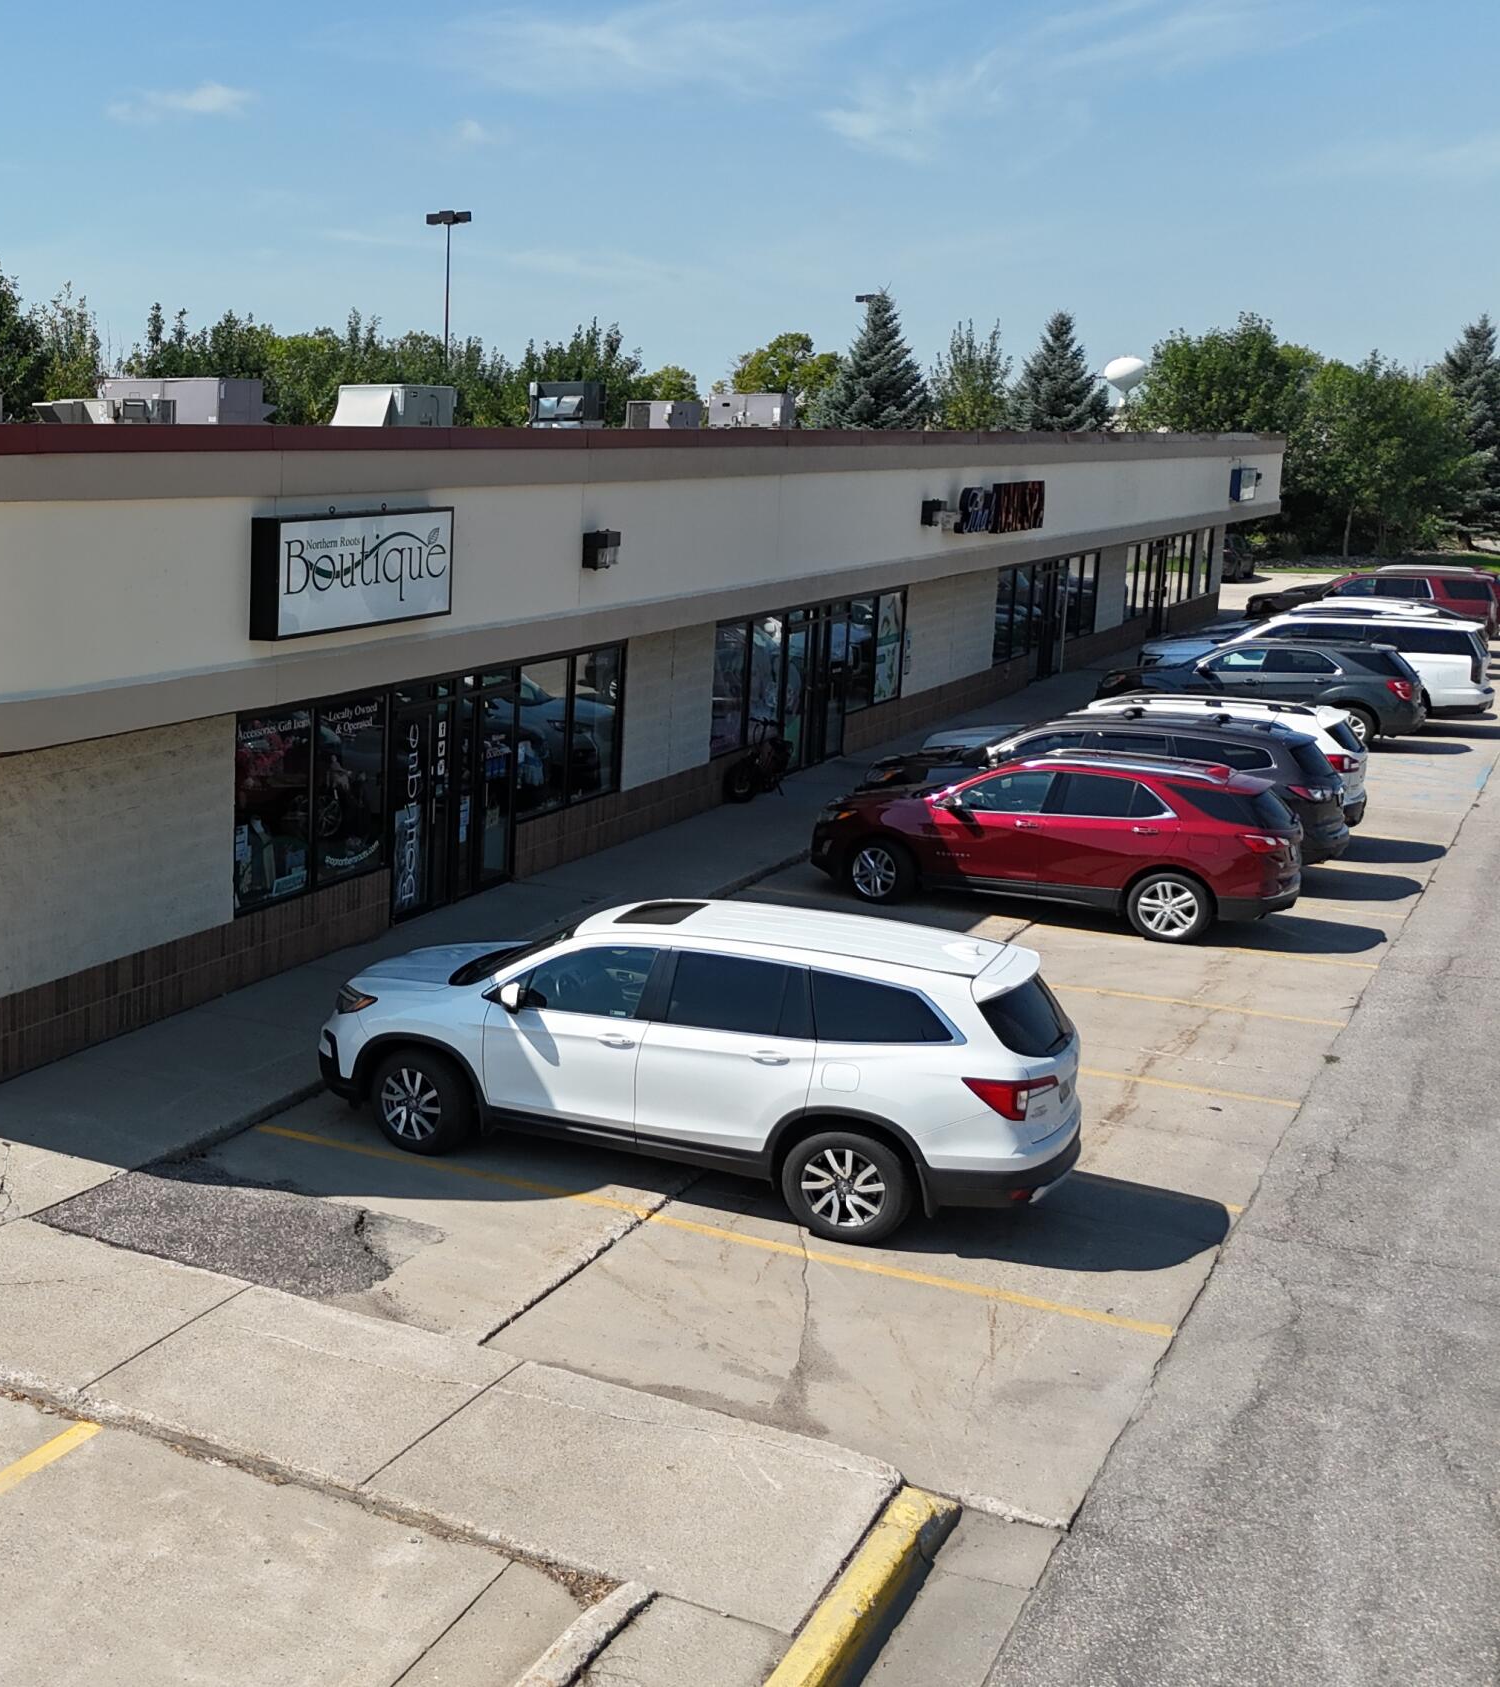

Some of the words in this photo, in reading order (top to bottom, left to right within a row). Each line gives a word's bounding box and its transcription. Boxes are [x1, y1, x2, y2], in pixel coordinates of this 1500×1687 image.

[305, 537, 339, 551] Northern
[340, 535, 361, 547] Roots
[284, 533, 447, 602] Boutique
[328, 708, 353, 721] Locally
[354, 702, 378, 716] Owned
[335, 724, 342, 735] &
[343, 717, 373, 733] Operated
[402, 723, 422, 903] Boutique
